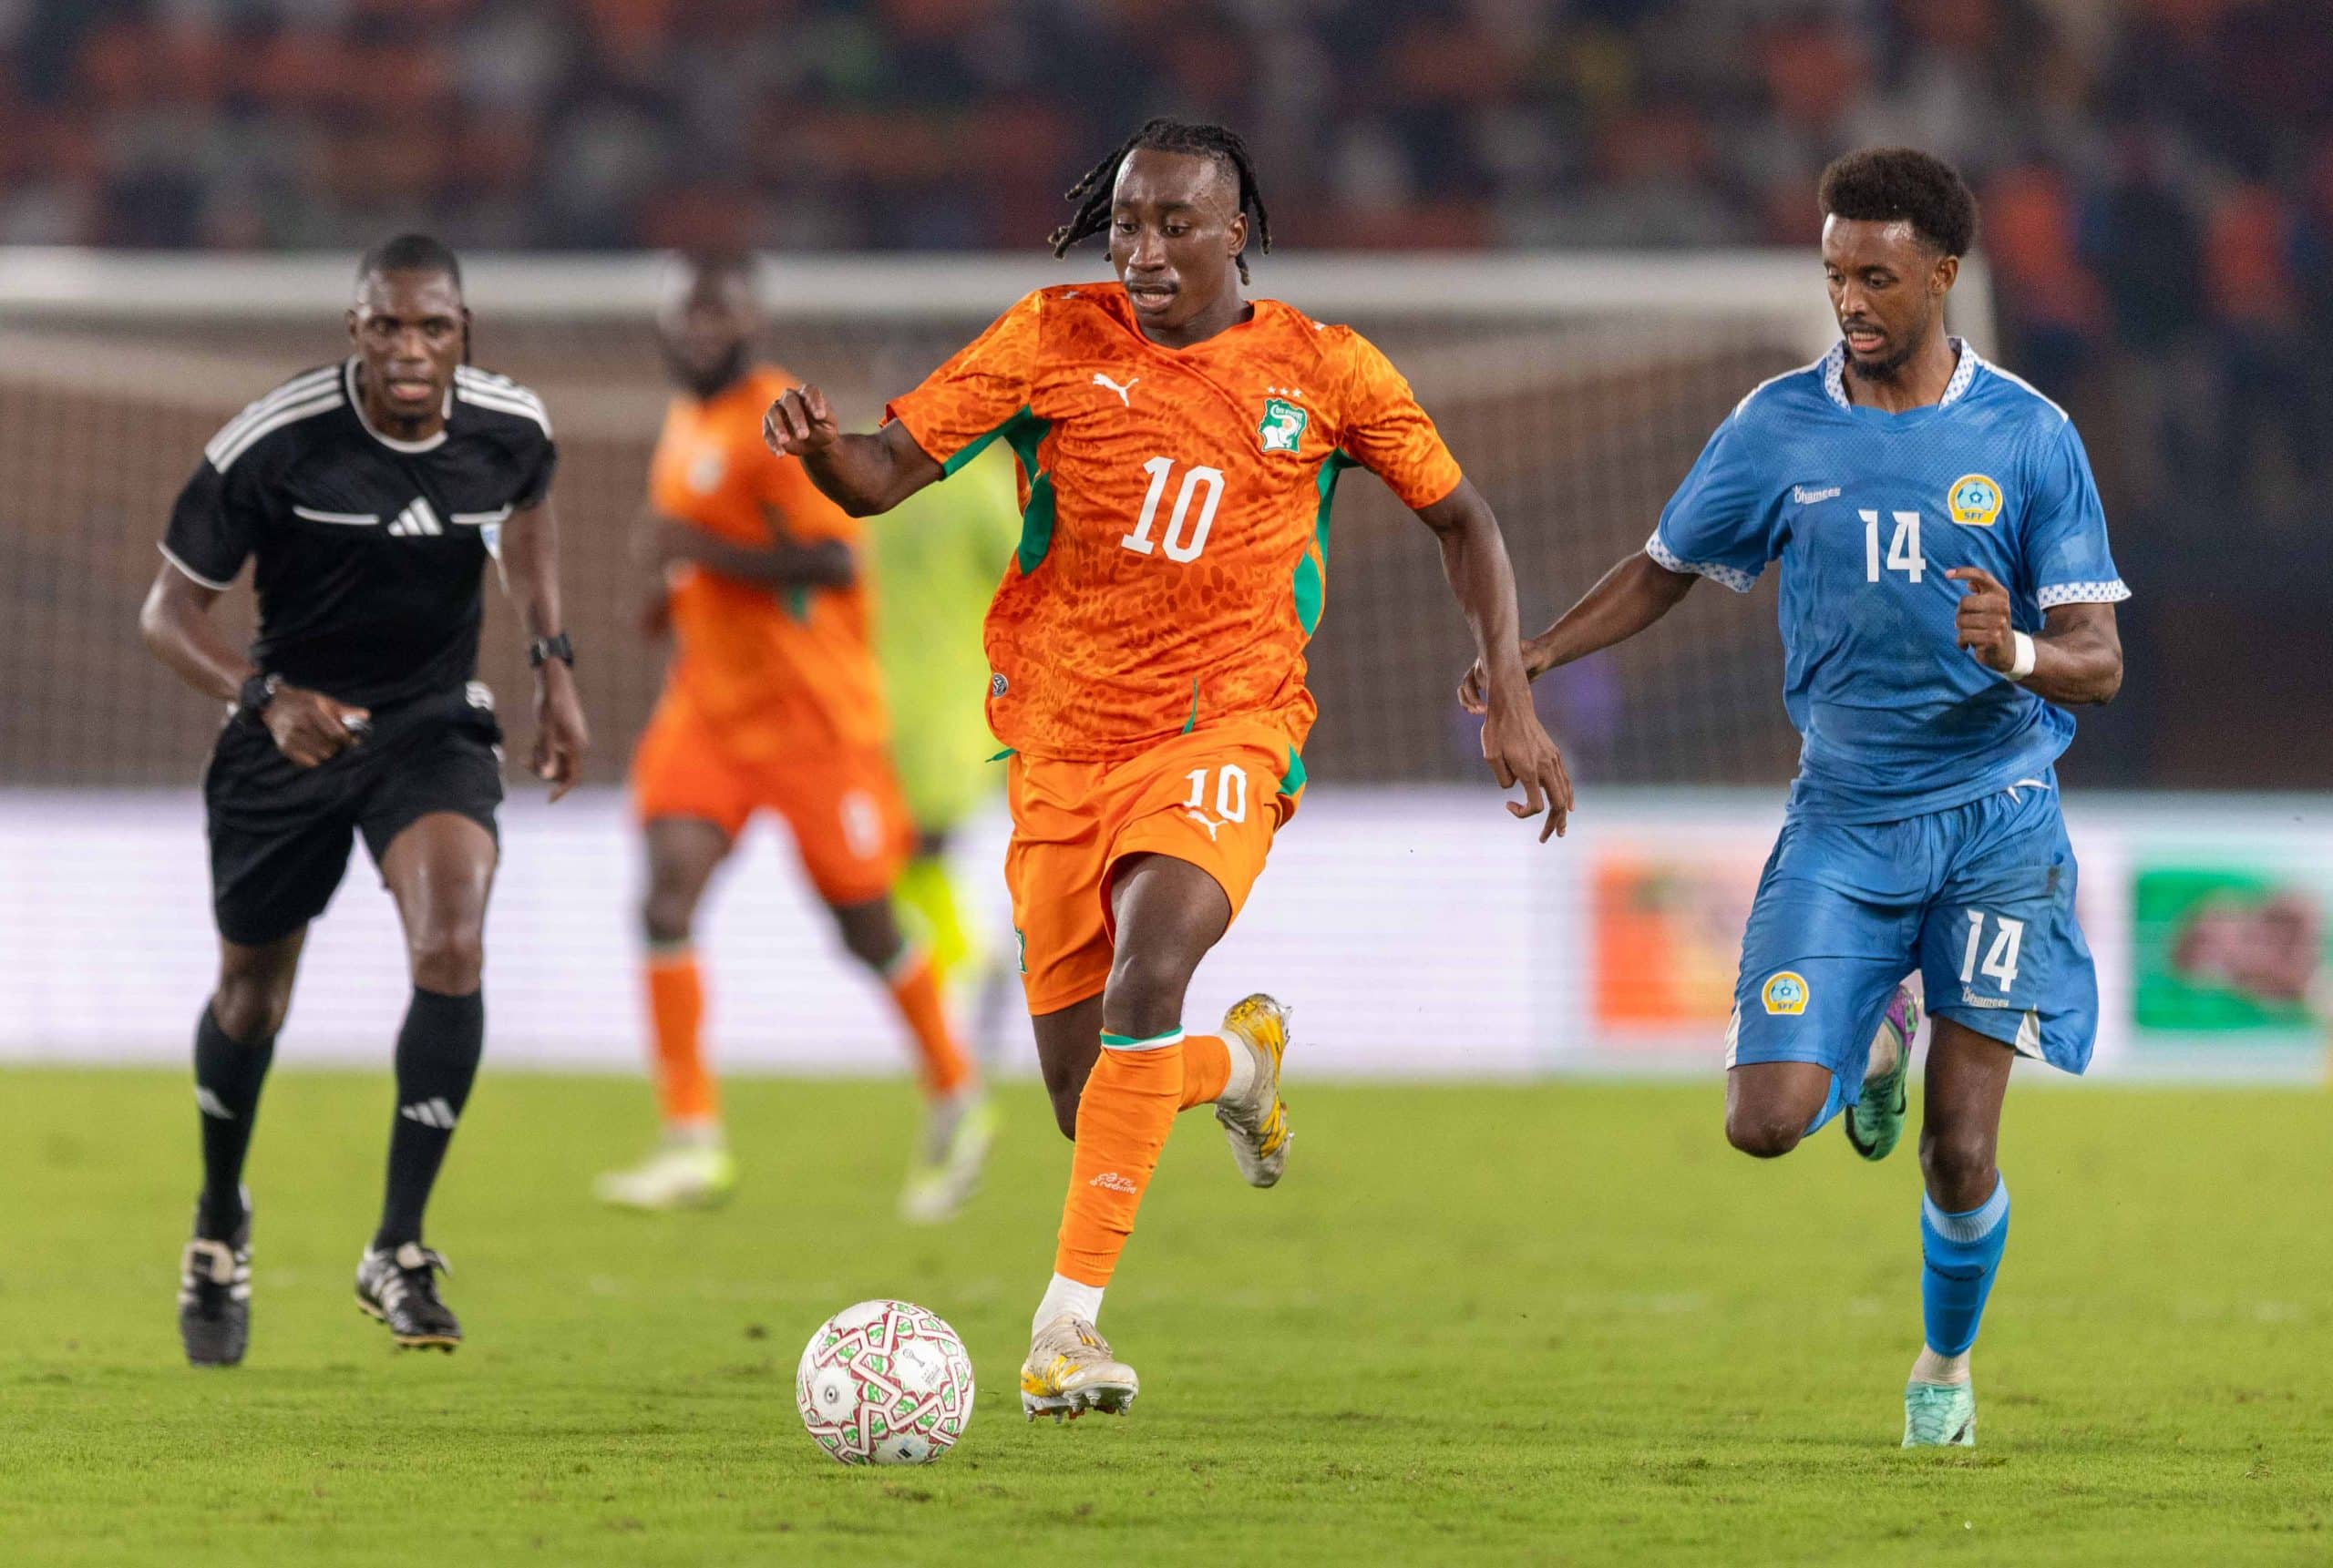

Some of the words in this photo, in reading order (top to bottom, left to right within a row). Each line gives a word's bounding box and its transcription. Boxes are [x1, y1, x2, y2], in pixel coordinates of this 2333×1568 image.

[1121, 456, 1226, 563] 10
[1857, 508, 1927, 583] 14
[1183, 764, 1247, 824] 10
[1959, 908, 2024, 992] 14
